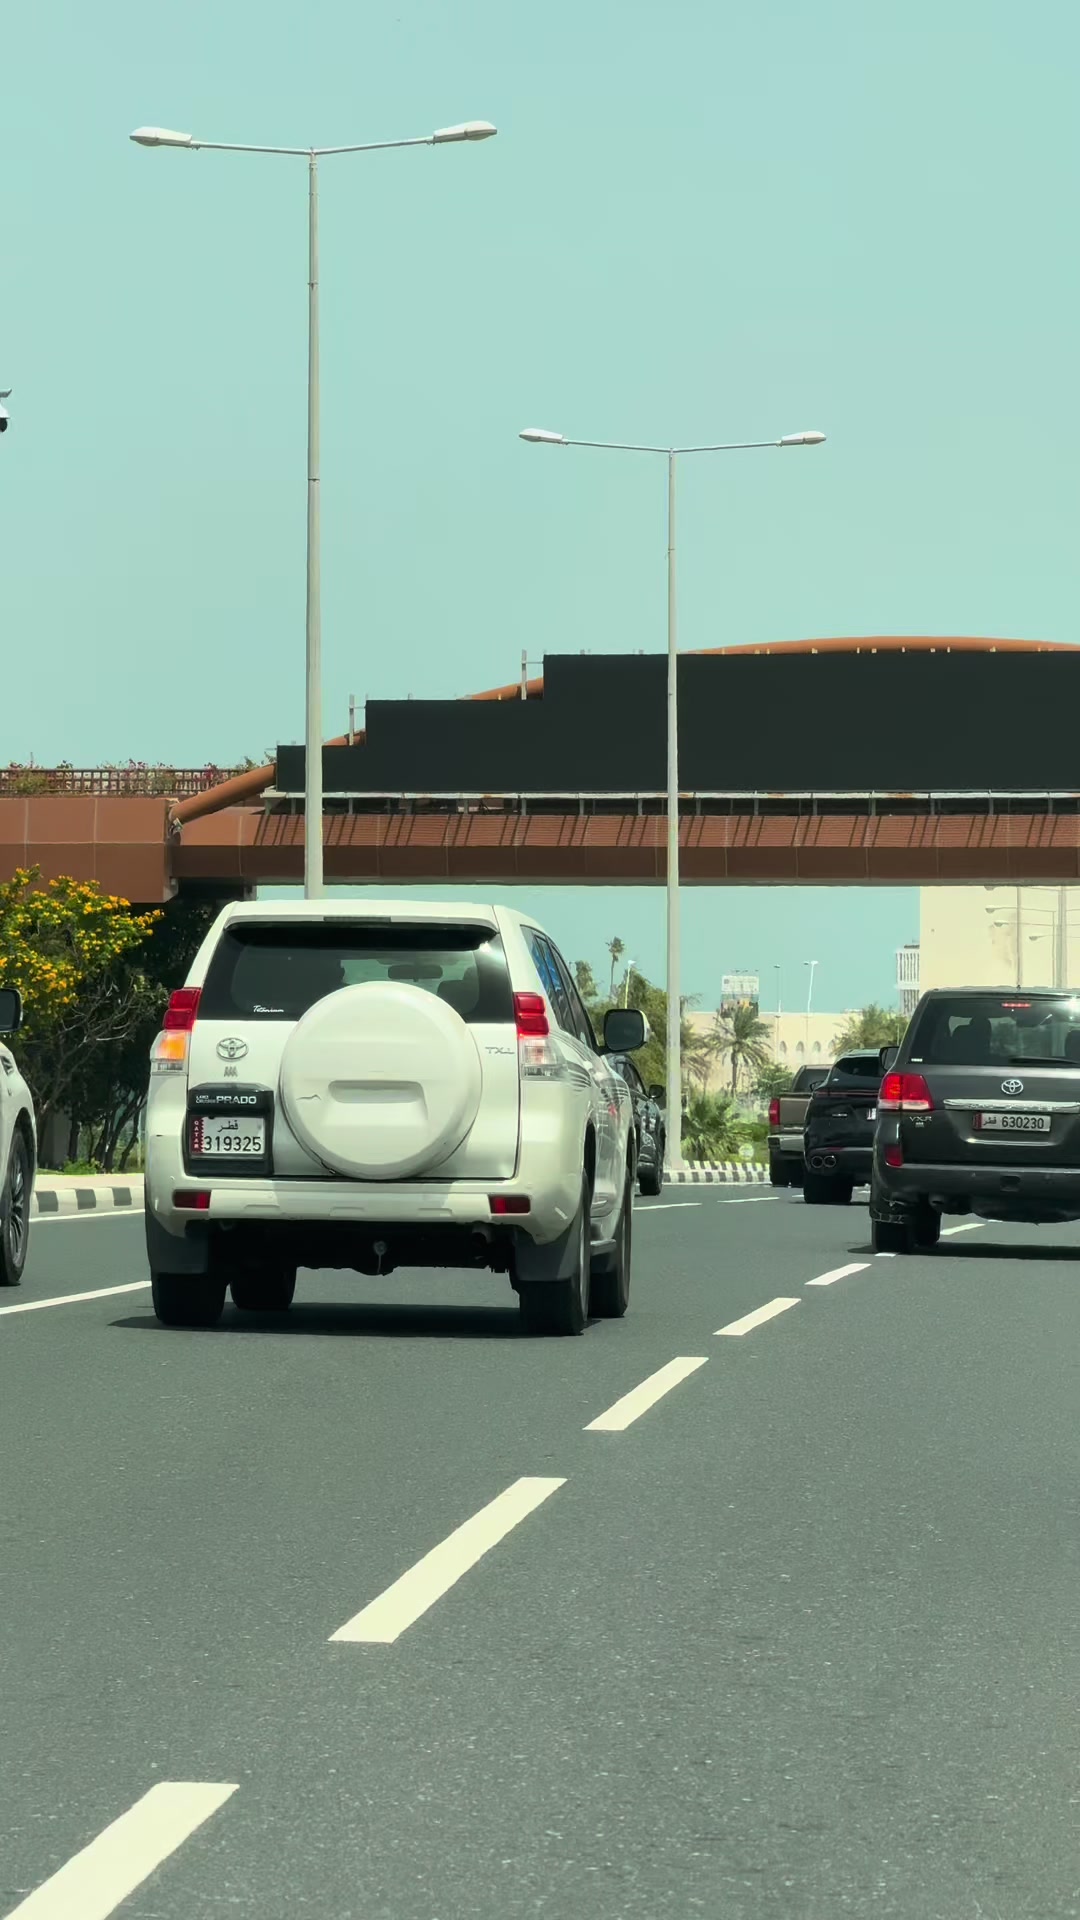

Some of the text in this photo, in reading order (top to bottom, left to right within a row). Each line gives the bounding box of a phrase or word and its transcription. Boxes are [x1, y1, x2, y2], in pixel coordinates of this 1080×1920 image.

[216, 1096, 256, 1104] PRADO
[218, 1120, 238, 1132] قطر
[1001, 1116, 1044, 1129] 630230
[204, 1136, 261, 1151] 319325
